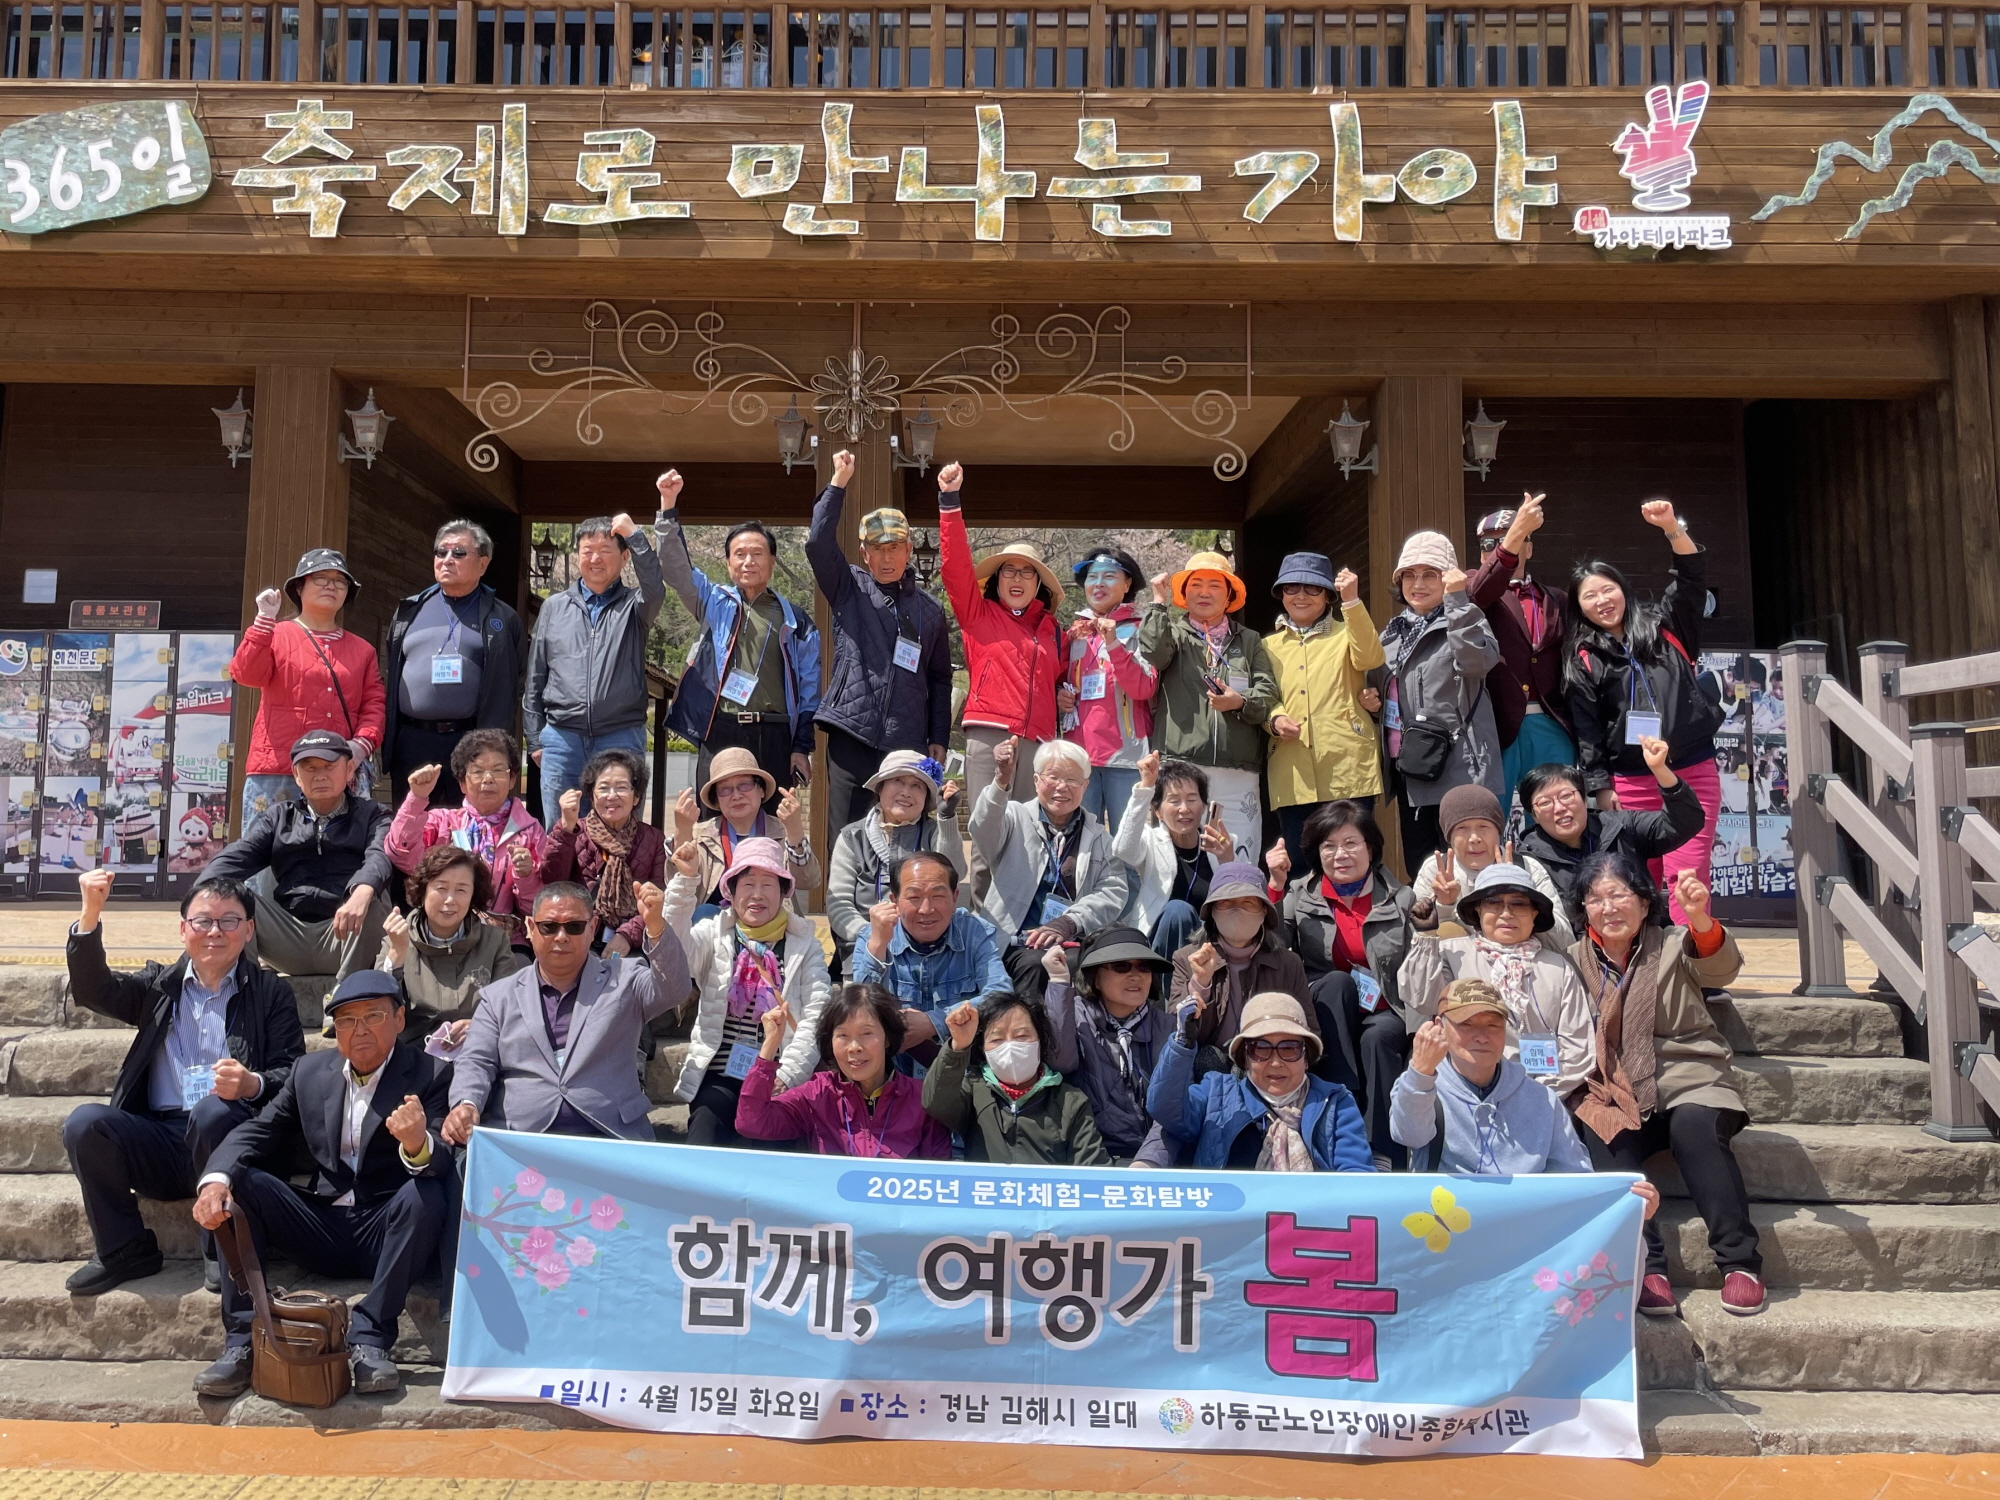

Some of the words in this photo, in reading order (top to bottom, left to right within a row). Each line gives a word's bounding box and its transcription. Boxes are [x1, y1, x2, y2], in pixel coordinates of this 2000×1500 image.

[3, 100, 199, 224] 365일
[231, 99, 691, 237] 축제로
[726, 102, 1201, 242] 만나는
[1234, 101, 1557, 242] 가야
[1579, 209, 1607, 230] 김해
[1597, 226, 1729, 246] 가야테마파크
[176, 690, 225, 710] 레일파크
[175, 755, 196, 766] 김해
[867, 1176, 960, 1204] 2025년
[971, 1180, 1213, 1208] 문화체험-문화탐방
[672, 1221, 873, 1339] 함께,
[922, 1237, 1209, 1347] 여행가
[1243, 1211, 1399, 1382] 봄
[560, 1380, 609, 1408] 일시
[638, 1385, 679, 1413] 4월
[689, 1386, 738, 1415] 15일
[748, 1387, 819, 1421] 화요일
[861, 1392, 909, 1421] 장소
[940, 1394, 989, 1423] 경남
[1000, 1396, 1075, 1427] 김해시
[1087, 1400, 1137, 1429] 일대
